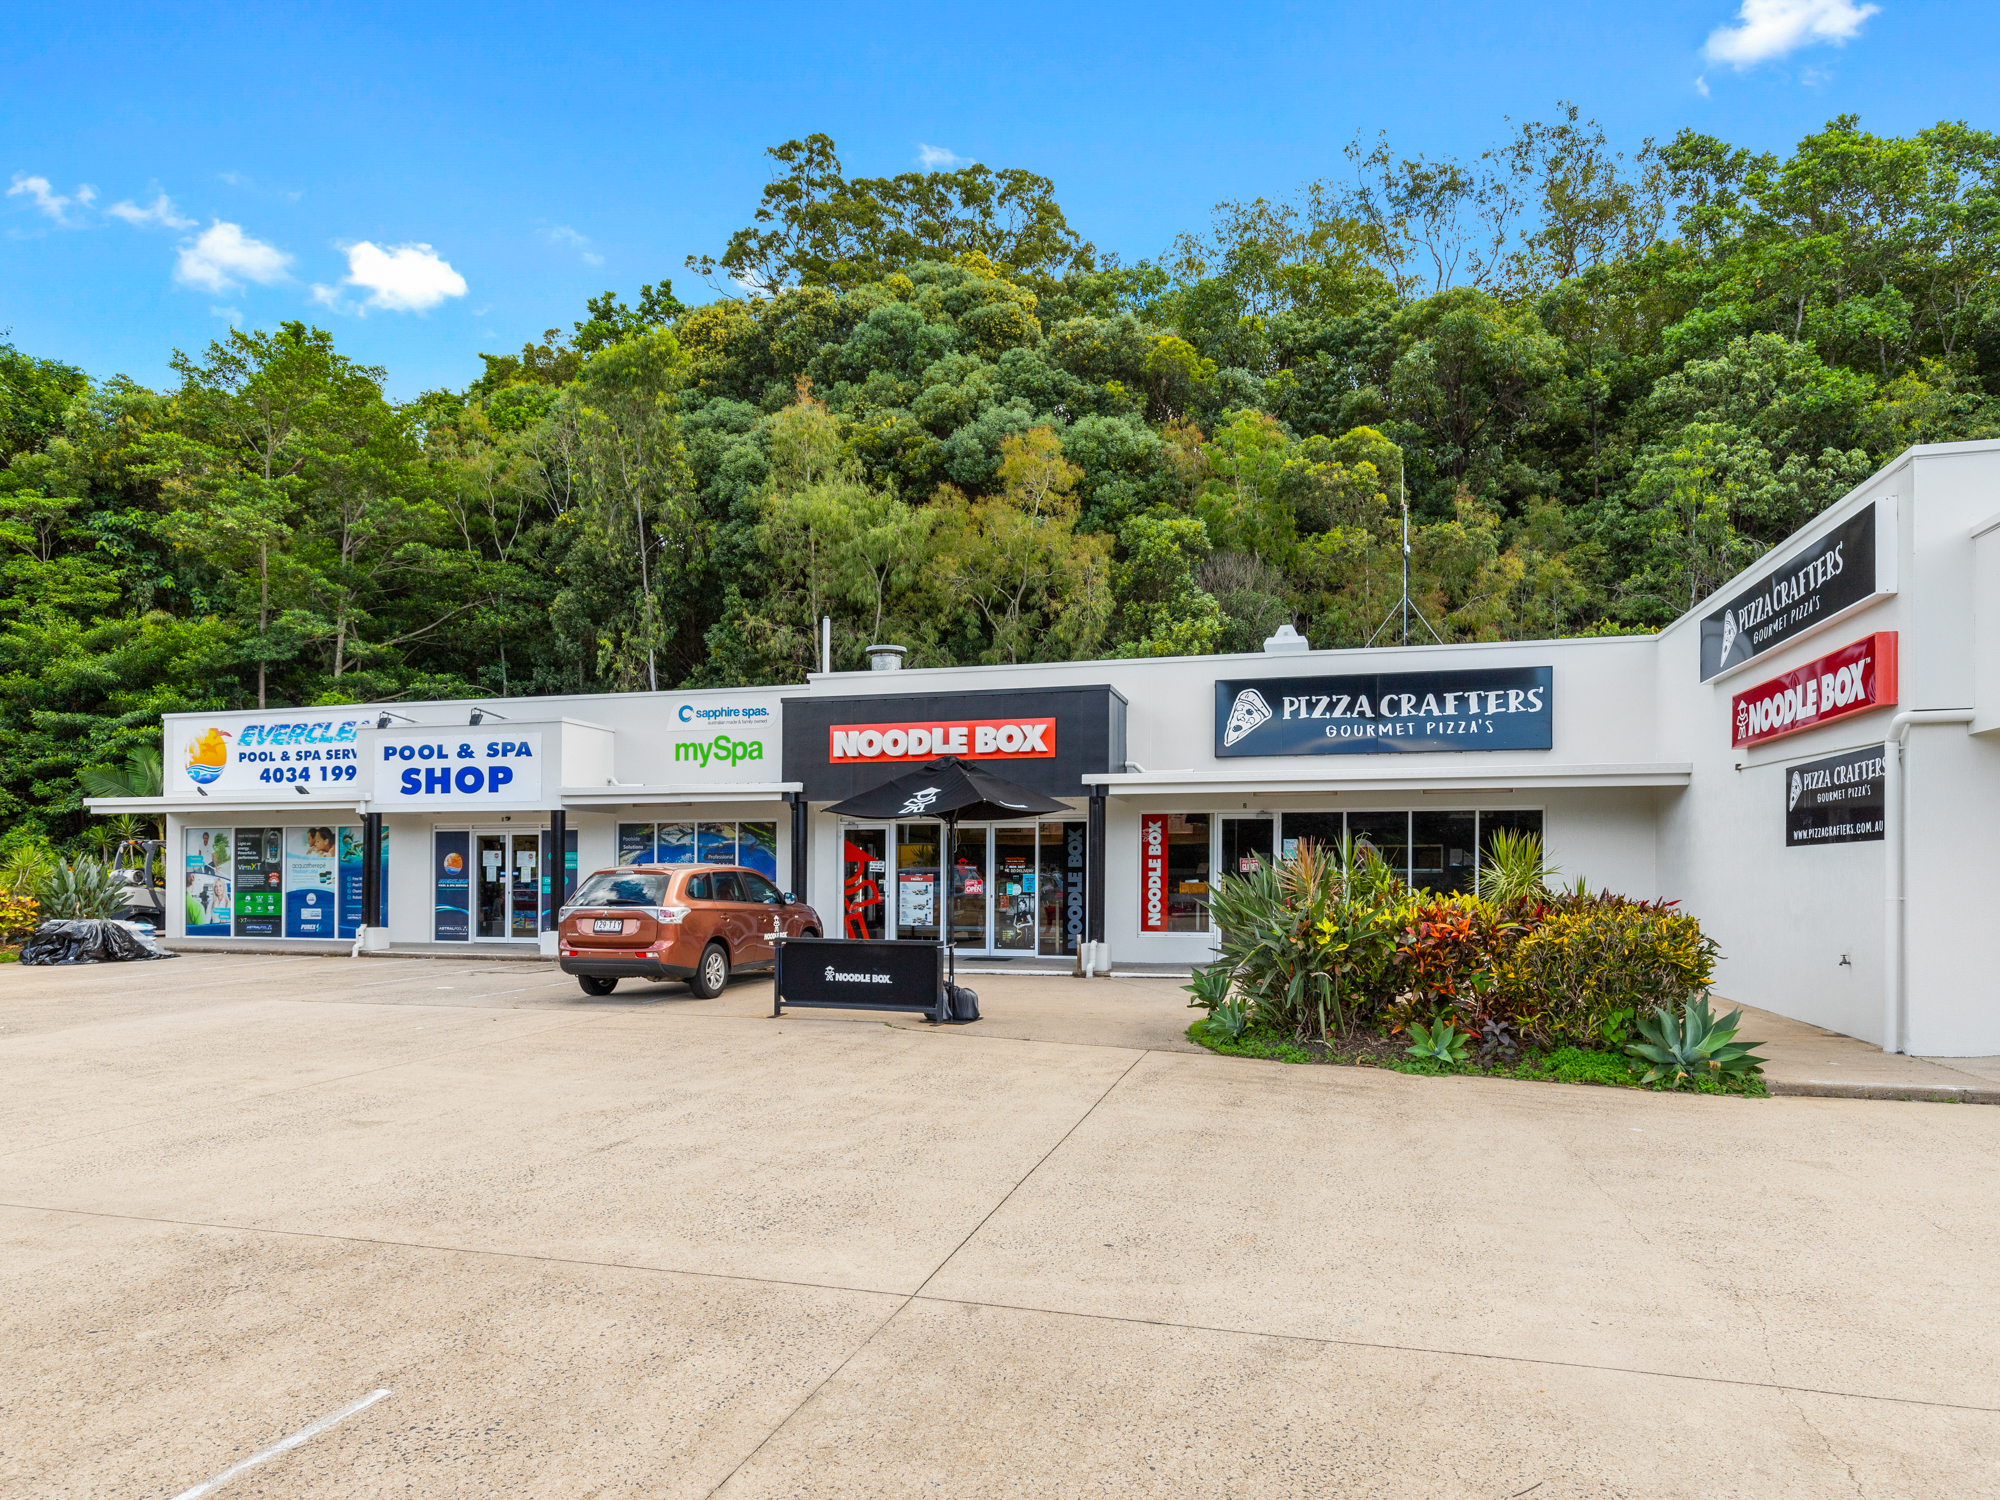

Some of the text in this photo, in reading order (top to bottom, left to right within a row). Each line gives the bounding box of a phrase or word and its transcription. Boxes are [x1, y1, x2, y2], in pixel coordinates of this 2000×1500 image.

[1738, 593, 1773, 633] PIZZA
[1753, 595, 1820, 644] GOURMET PIZZA'S
[1282, 694, 1375, 720] PIZZA
[1748, 678, 1818, 736] NOODLE
[1821, 658, 1866, 713] BOX
[695, 706, 740, 720] sapphire
[237, 720, 370, 746] EVERCLE
[833, 724, 1049, 758] NOODLE BOX
[1325, 719, 1494, 738] GOURMET PIZZA'S
[238, 749, 357, 763] POOL & SPA SERV
[383, 741, 533, 761] POOL & SPA
[675, 734, 764, 768] mySpa
[259, 765, 357, 783] 4034 199
[400, 766, 514, 795] SHOP
[1803, 769, 1832, 791] PIZZA
[1817, 783, 1871, 803] GOURMET PIZZA'S
[1793, 820, 1884, 840] WWW.PIZZACRAFTERS.COM.AU
[1147, 820, 1162, 926] NOODLE BOX
[1067, 827, 1083, 949] NOODLE BOX
[835, 972, 871, 983] NOODLE
